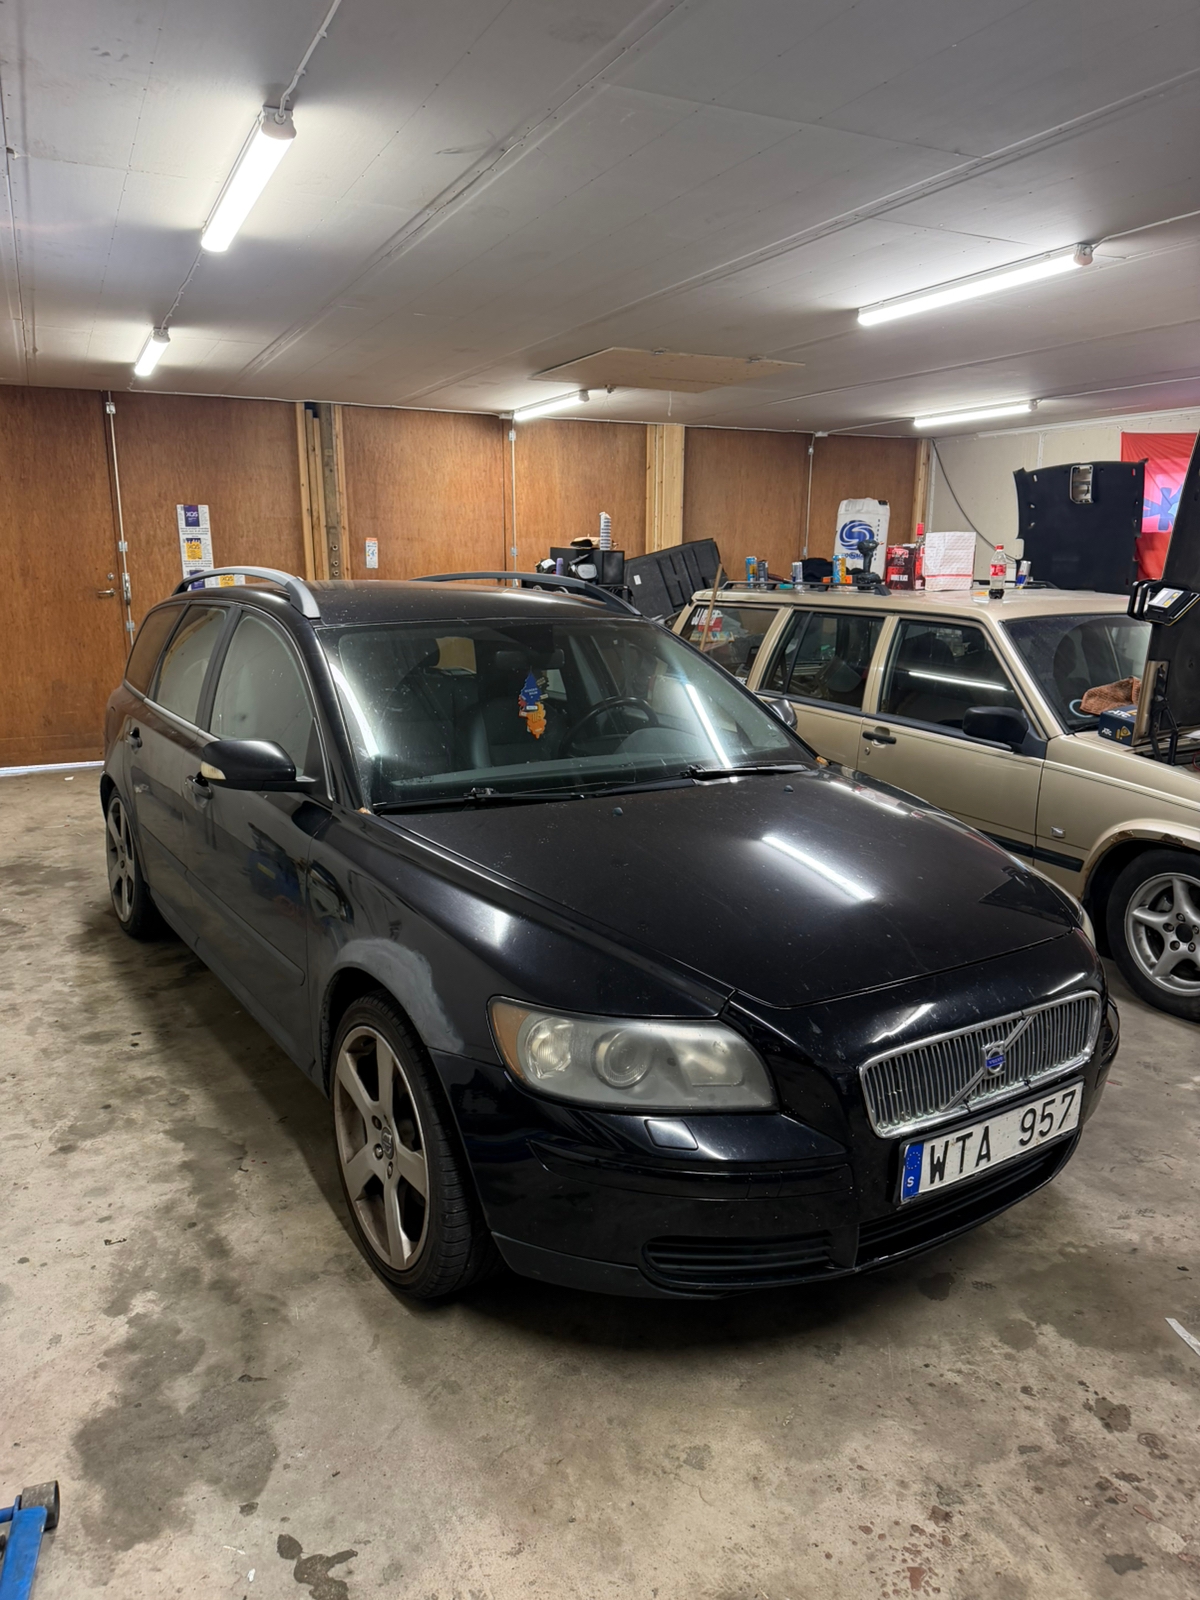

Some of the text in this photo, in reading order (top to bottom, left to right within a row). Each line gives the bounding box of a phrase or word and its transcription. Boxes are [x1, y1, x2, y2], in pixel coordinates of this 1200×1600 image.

[929, 1089, 1077, 1184] WTA 957
[906, 1175, 915, 1188] S
